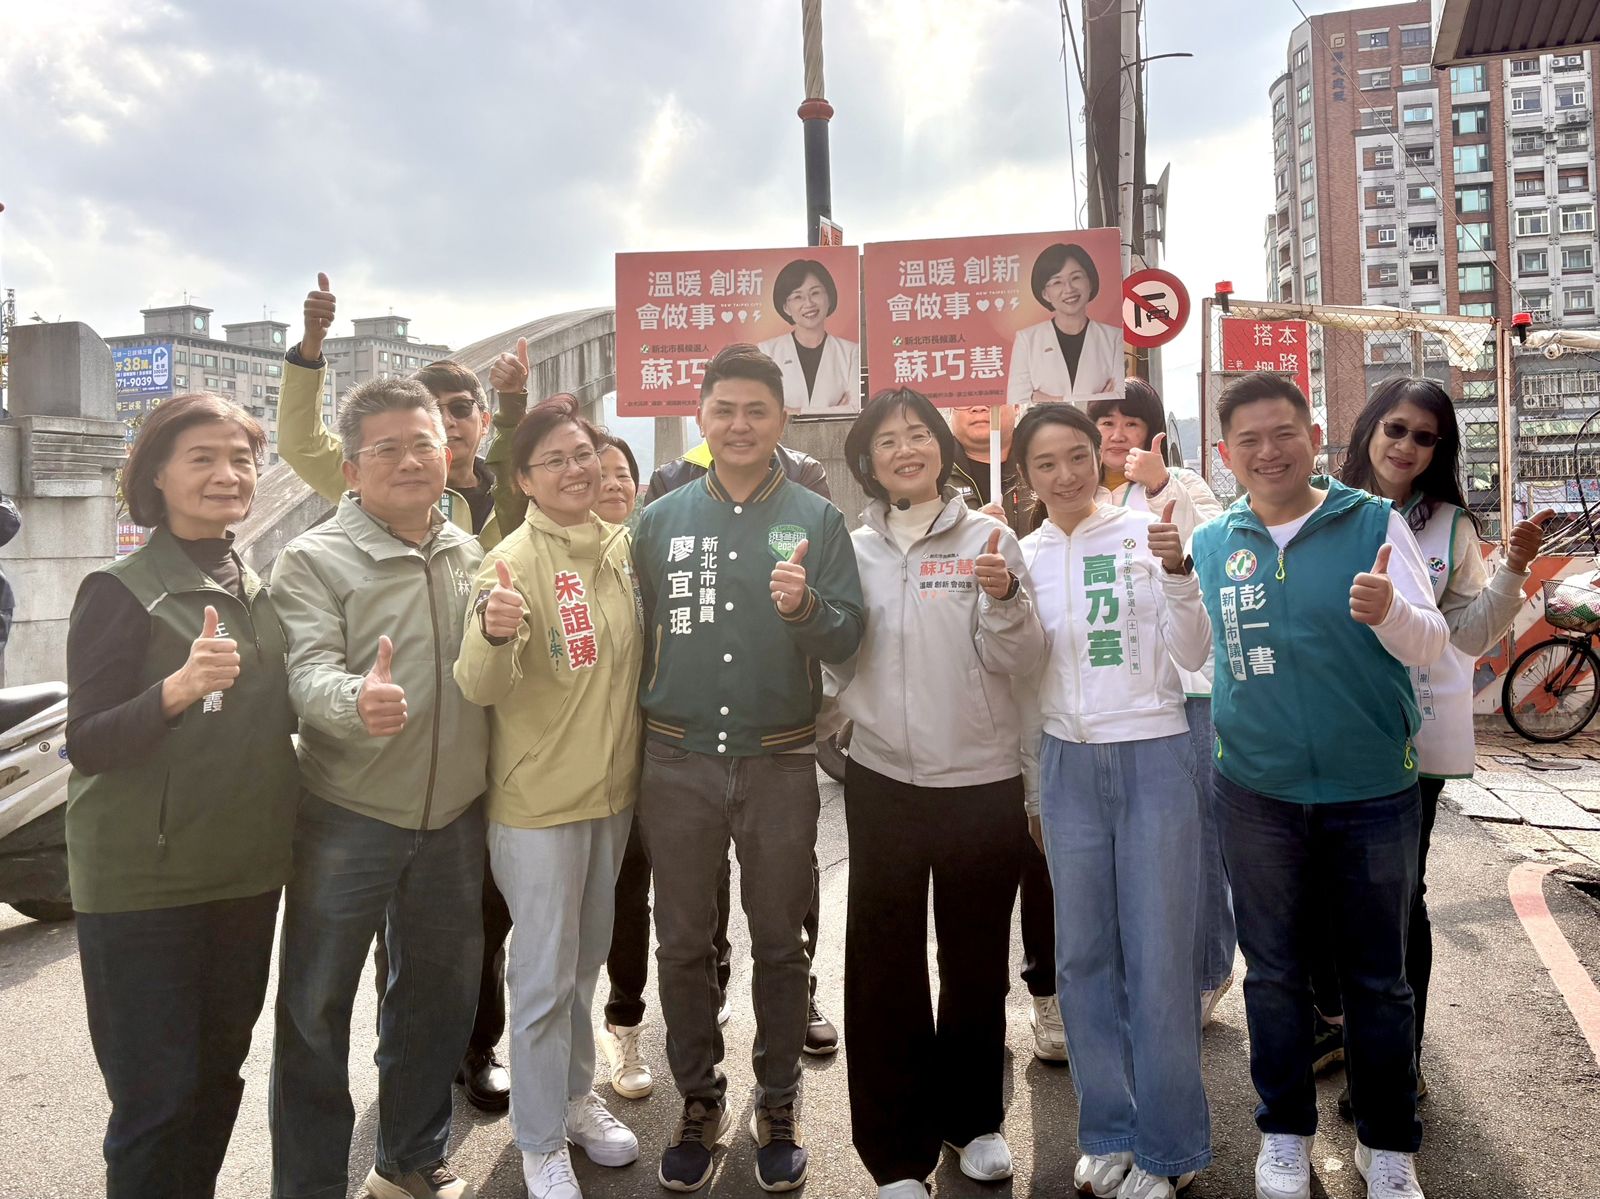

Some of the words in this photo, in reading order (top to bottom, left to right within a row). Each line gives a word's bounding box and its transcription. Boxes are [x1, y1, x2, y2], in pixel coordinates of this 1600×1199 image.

[648, 269, 702, 297] 溫暖
[709, 268, 763, 297] 創新
[898, 257, 955, 288] 溫暖
[963, 254, 1020, 285] 創新
[636, 302, 716, 330] 會做事
[887, 291, 971, 322] 會做事
[652, 343, 710, 354] 新北市長候選人
[905, 334, 966, 345] 新北市長候選人
[640, 356, 710, 390] 蘇巧
[893, 346, 1005, 383] 蘇巧慧
[115, 376, 152, 388] 71-9039
[777, 542, 797, 551] 2024
[699, 536, 719, 623] 新北市議員
[920, 559, 974, 576] 蘇巧慧
[920, 581, 933, 589] 溫暖
[934, 581, 949, 589] 創新
[950, 580, 973, 589] 會做事
[667, 535, 696, 635] 廖宜琨
[1123, 553, 1136, 617] 新北市議員參選人
[554, 570, 598, 669] 朱誼臻
[1083, 554, 1124, 667] 高乃芸
[1221, 592, 1244, 675] 新北市議員
[1239, 583, 1277, 676] 彭一書
